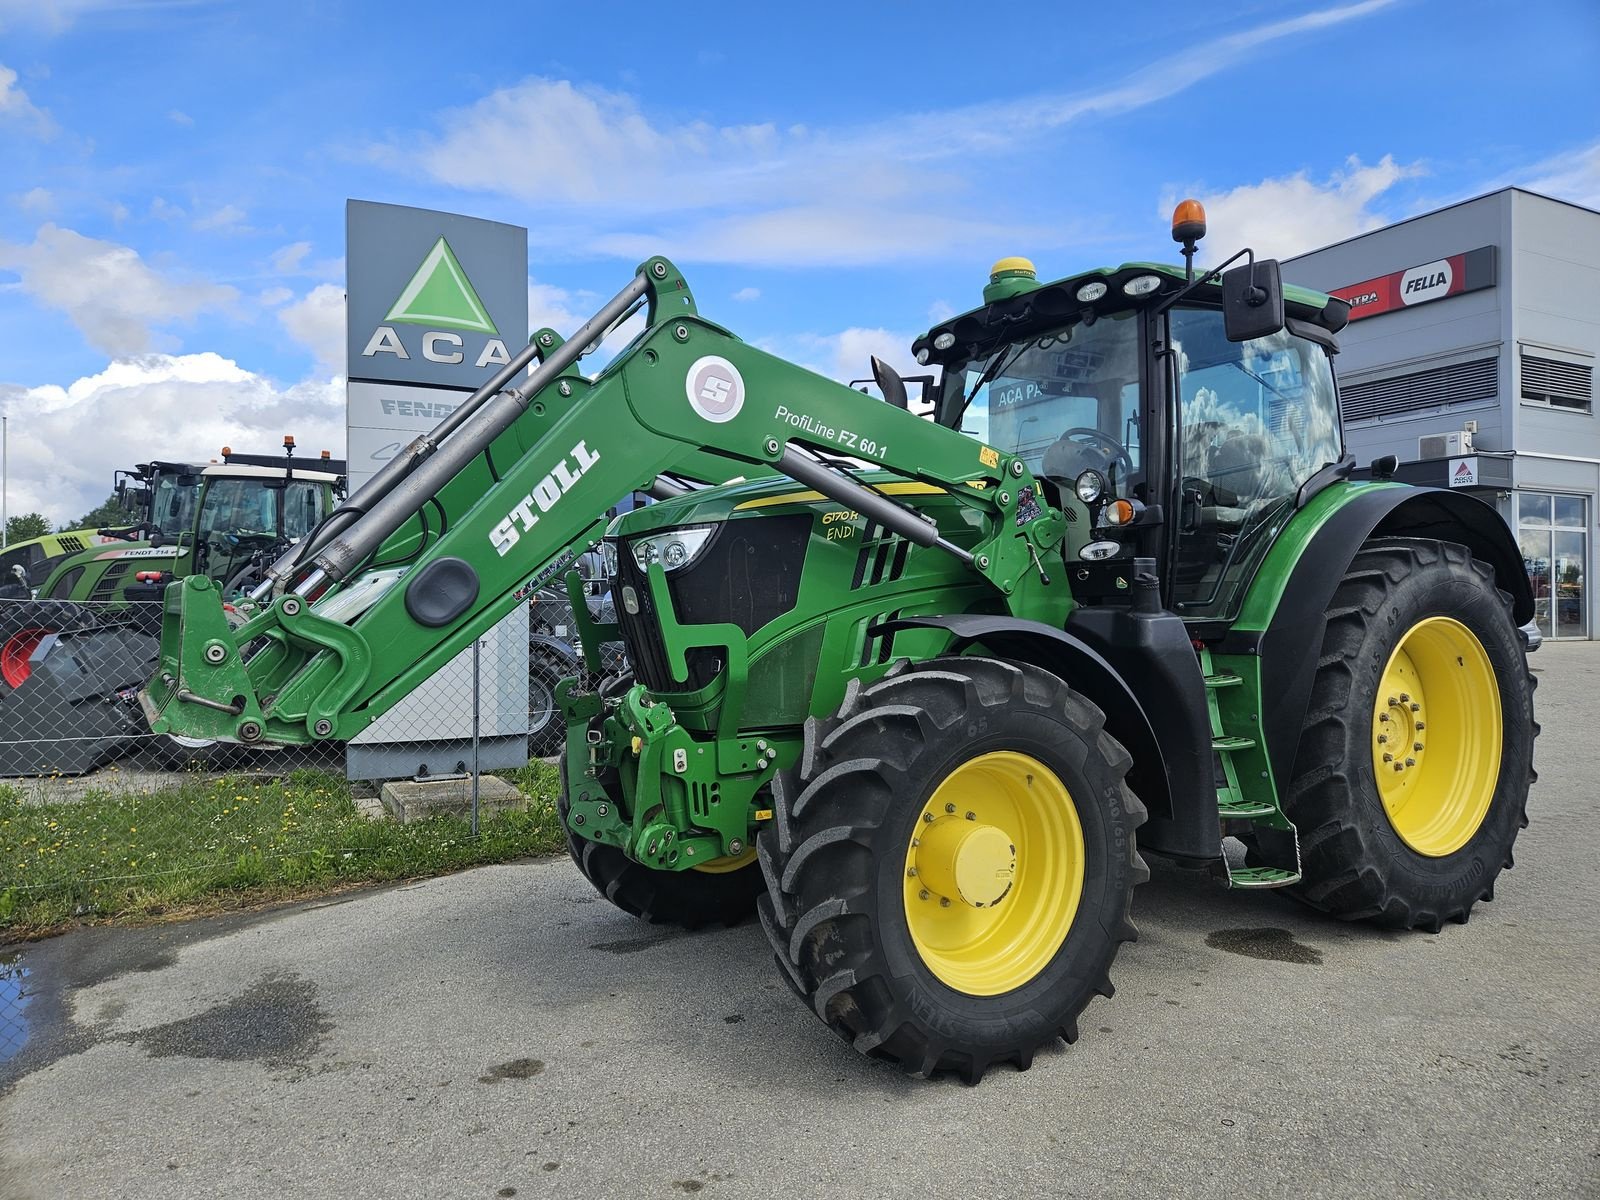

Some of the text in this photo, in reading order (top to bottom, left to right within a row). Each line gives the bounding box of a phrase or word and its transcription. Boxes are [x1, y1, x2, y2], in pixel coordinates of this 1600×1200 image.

[1405, 272, 1447, 294] FELLA
[1349, 291, 1378, 306] LTRA
[361, 326, 513, 368] ACA
[998, 387, 1023, 407] ACA
[380, 399, 461, 420] FEND
[774, 405, 887, 459] ProfiLine FZ 60.1
[489, 439, 600, 557] STOLL
